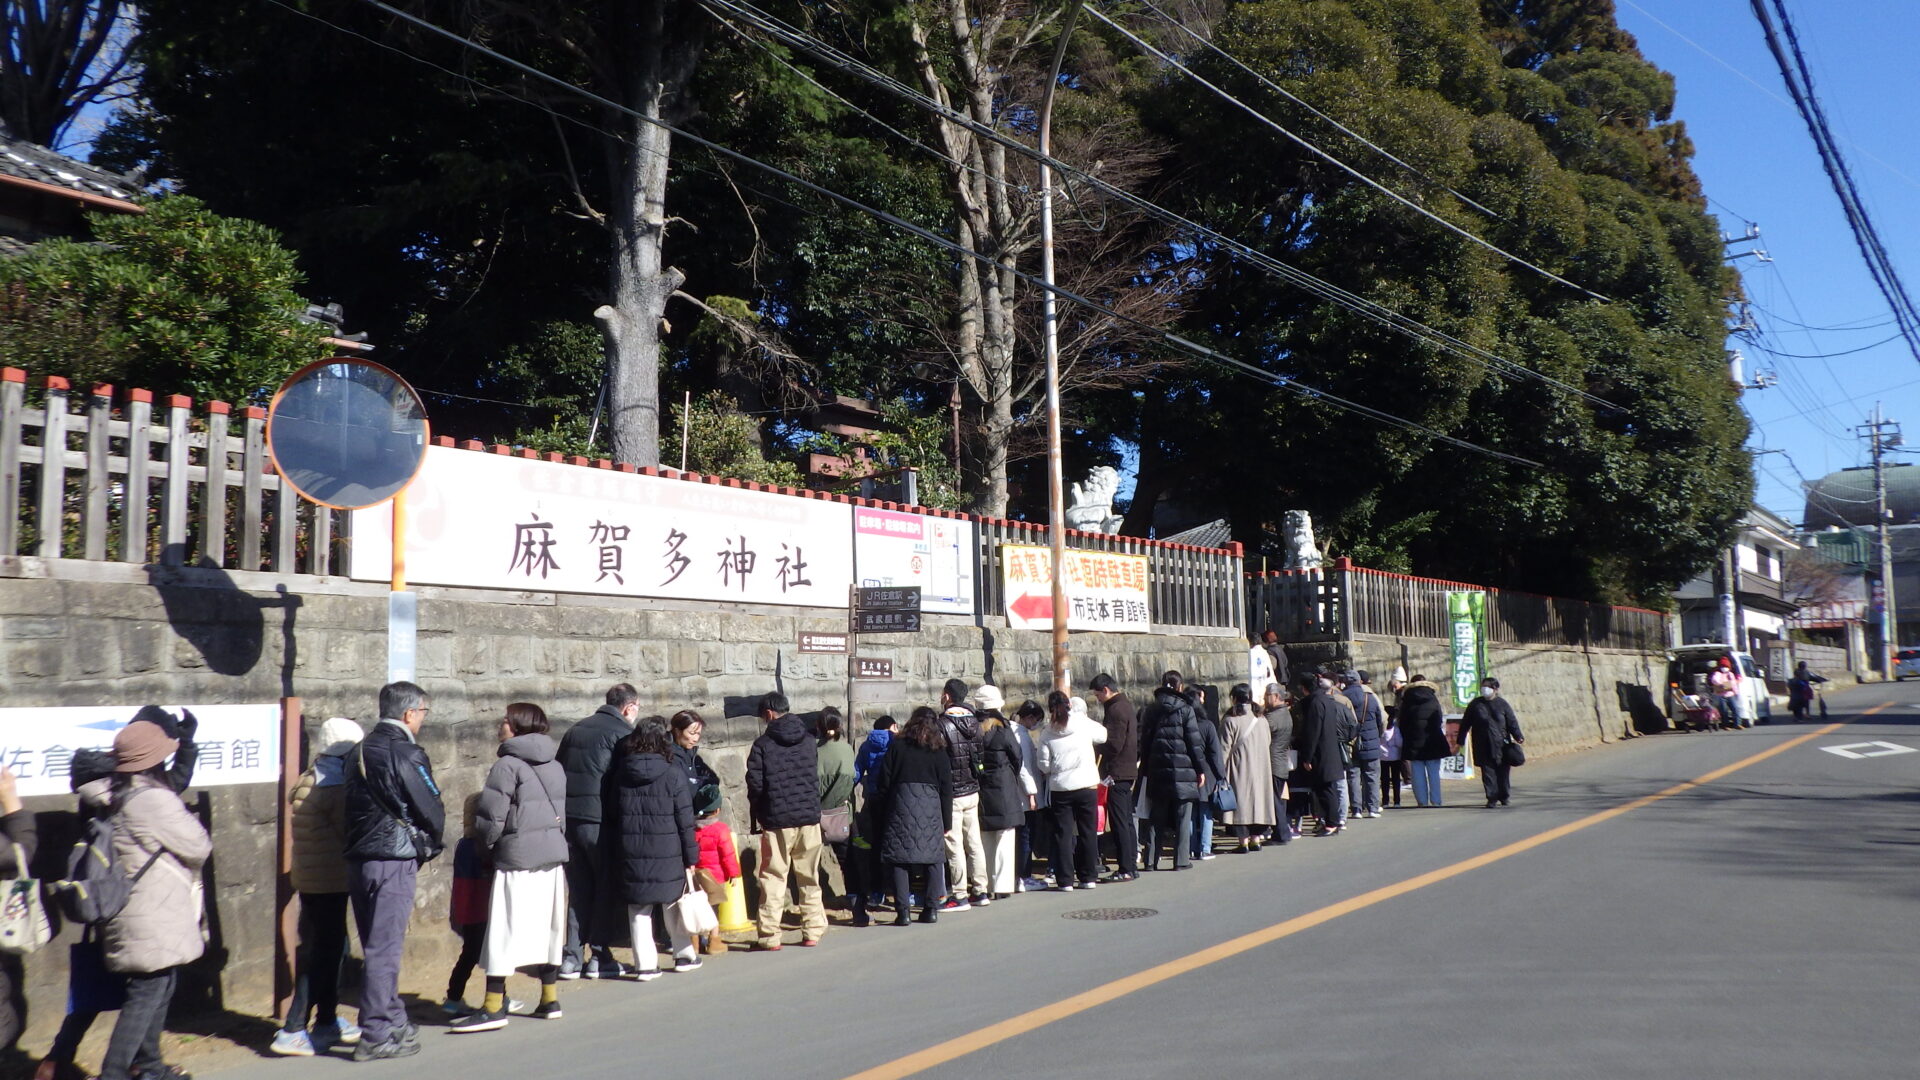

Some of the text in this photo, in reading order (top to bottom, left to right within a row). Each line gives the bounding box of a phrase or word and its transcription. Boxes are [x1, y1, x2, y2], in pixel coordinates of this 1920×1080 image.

[508, 513, 813, 595] 麻賀多神社
[1009, 550, 1145, 591] 麻賀多社臨時駐車場
[0, 739, 261, 779] 佐倉育館
